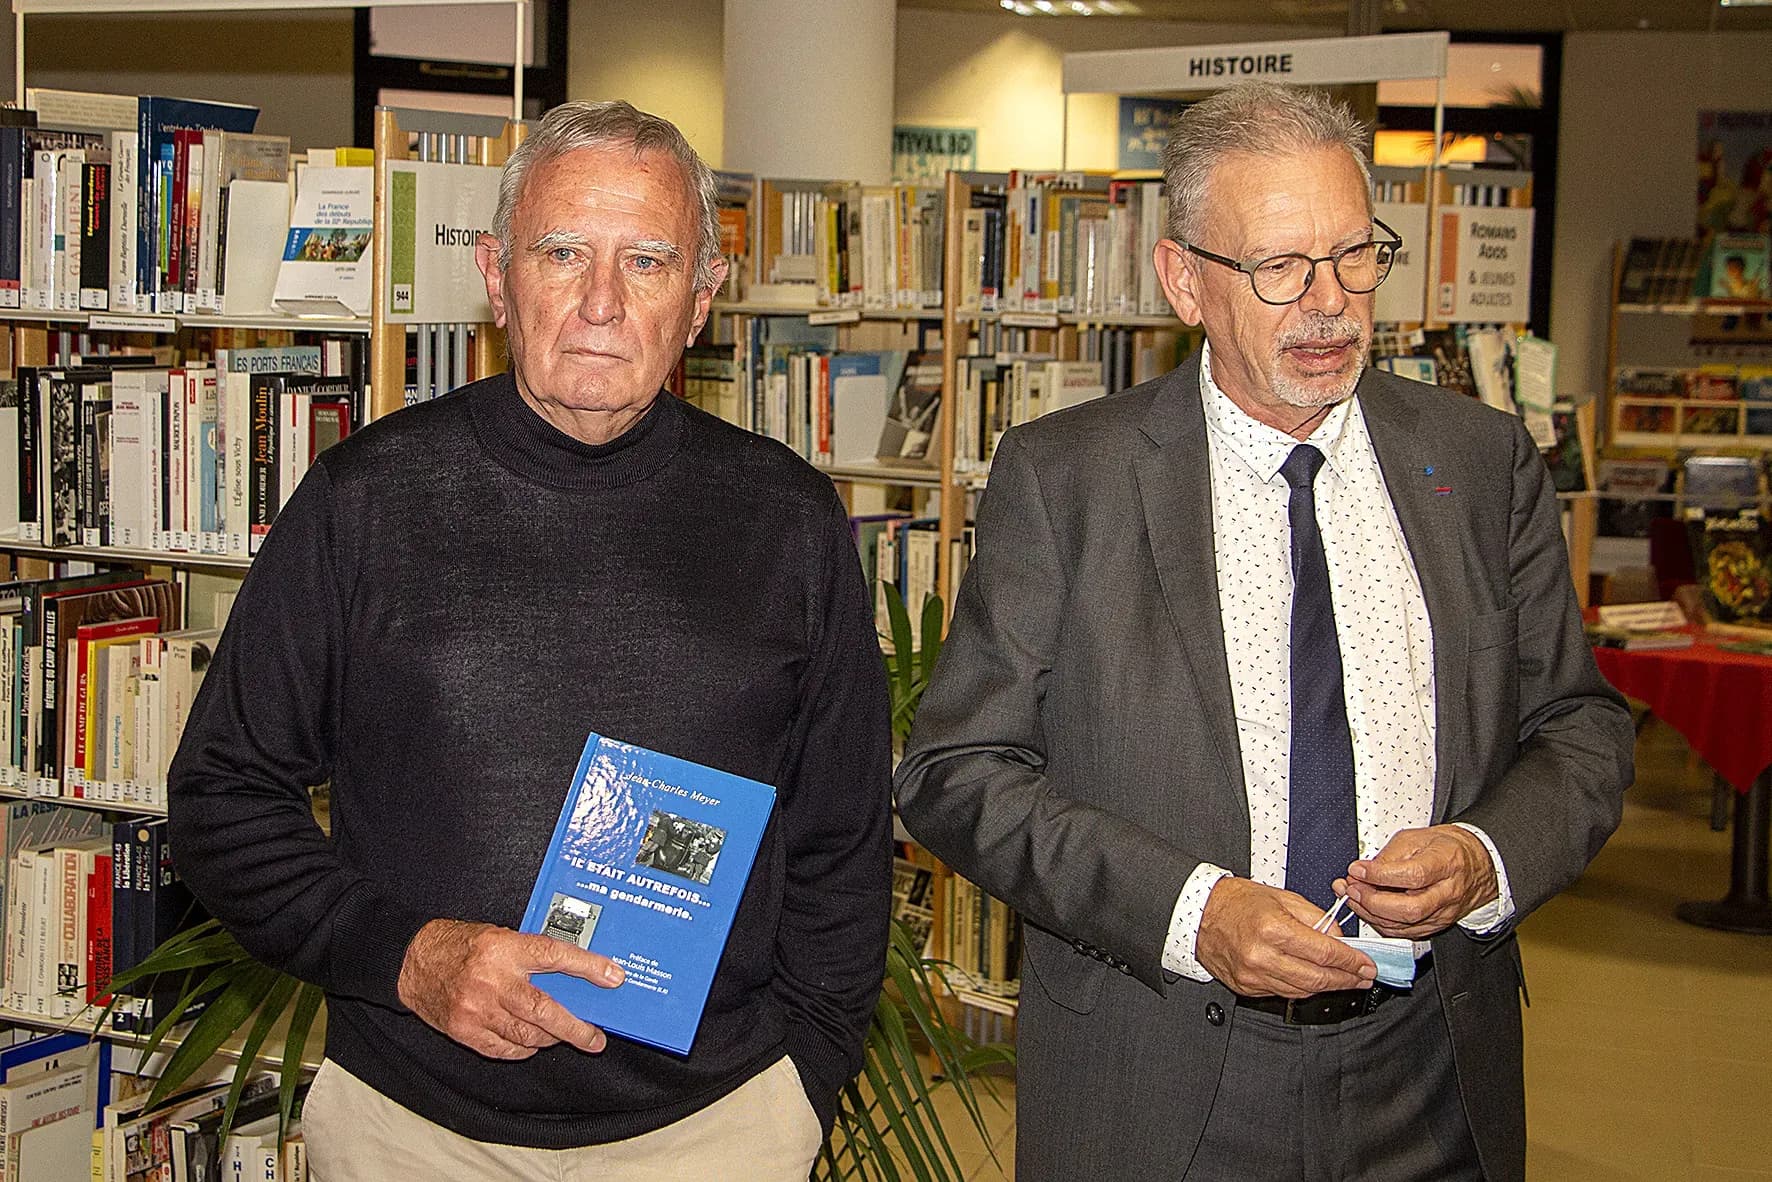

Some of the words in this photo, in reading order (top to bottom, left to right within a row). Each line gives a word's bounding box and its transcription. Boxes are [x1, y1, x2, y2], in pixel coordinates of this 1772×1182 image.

[1189, 54, 1292, 77] HISTOIRE
[69, 183, 81, 277] GALLIENI
[1470, 222, 1517, 240] ROMANS
[396, 291, 409, 302] 944
[251, 357, 278, 371] PORTS
[255, 386, 267, 431] Moulin
[233, 437, 243, 458] Vichy
[255, 435, 267, 464] Jean
[234, 459, 242, 477] sous
[234, 478, 244, 507] L'Église
[46, 610, 56, 634] MILLES
[46, 634, 56, 648] DES
[45, 649, 55, 668] CAMP
[45, 669, 55, 678] DU
[79, 672, 87, 698] GURS
[45, 677, 55, 709] MÉMOIRE
[78, 714, 86, 741] CAMP
[112, 715, 123, 757] quatre-vingts
[112, 757, 120, 769] Les
[622, 771, 689, 797] Jean-Charles
[689, 790, 721, 806] Meyer
[13, 804, 28, 819] LA
[122, 843, 131, 880] Libération
[135, 865, 143, 891] FRANCE
[626, 873, 711, 908] AUTREFOIS...
[63, 852, 77, 941] COLLABORATION
[609, 889, 693, 921] gendarmerie.
[612, 955, 646, 972] Jean-Louis
[645, 966, 673, 980] Masson
[629, 952, 651, 965] Préface
[651, 959, 659, 967] de
[117, 1014, 125, 1023] 2
